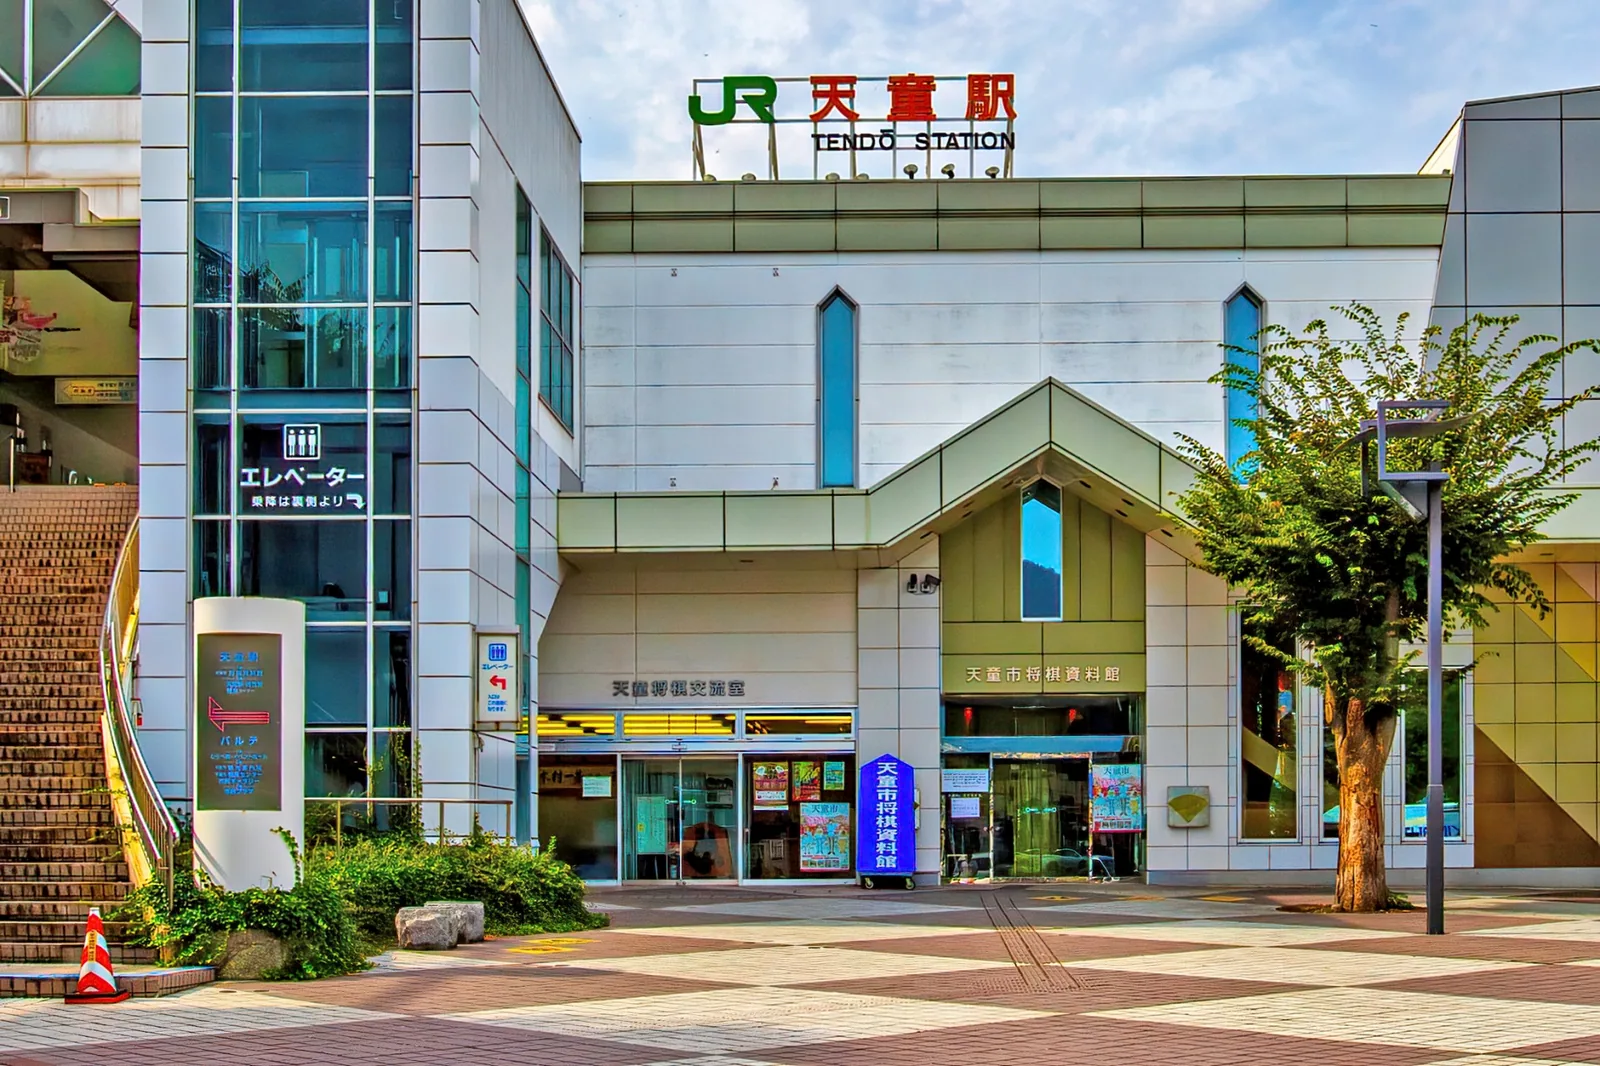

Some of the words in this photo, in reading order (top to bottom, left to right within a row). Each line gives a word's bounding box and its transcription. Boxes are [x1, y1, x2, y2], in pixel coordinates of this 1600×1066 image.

[688, 75, 778, 125] JR
[809, 73, 1017, 121] 天童駅
[811, 129, 895, 151] TENDŌ
[915, 131, 1016, 151] STATION
[240, 466, 365, 487] エレベーター
[251, 495, 343, 508] 乗降は裏側より
[966, 666, 1120, 682] 天童市将棋資料館
[612, 680, 745, 697] 天童将棋交流室
[876, 762, 898, 868] 天童市将棋資料館
